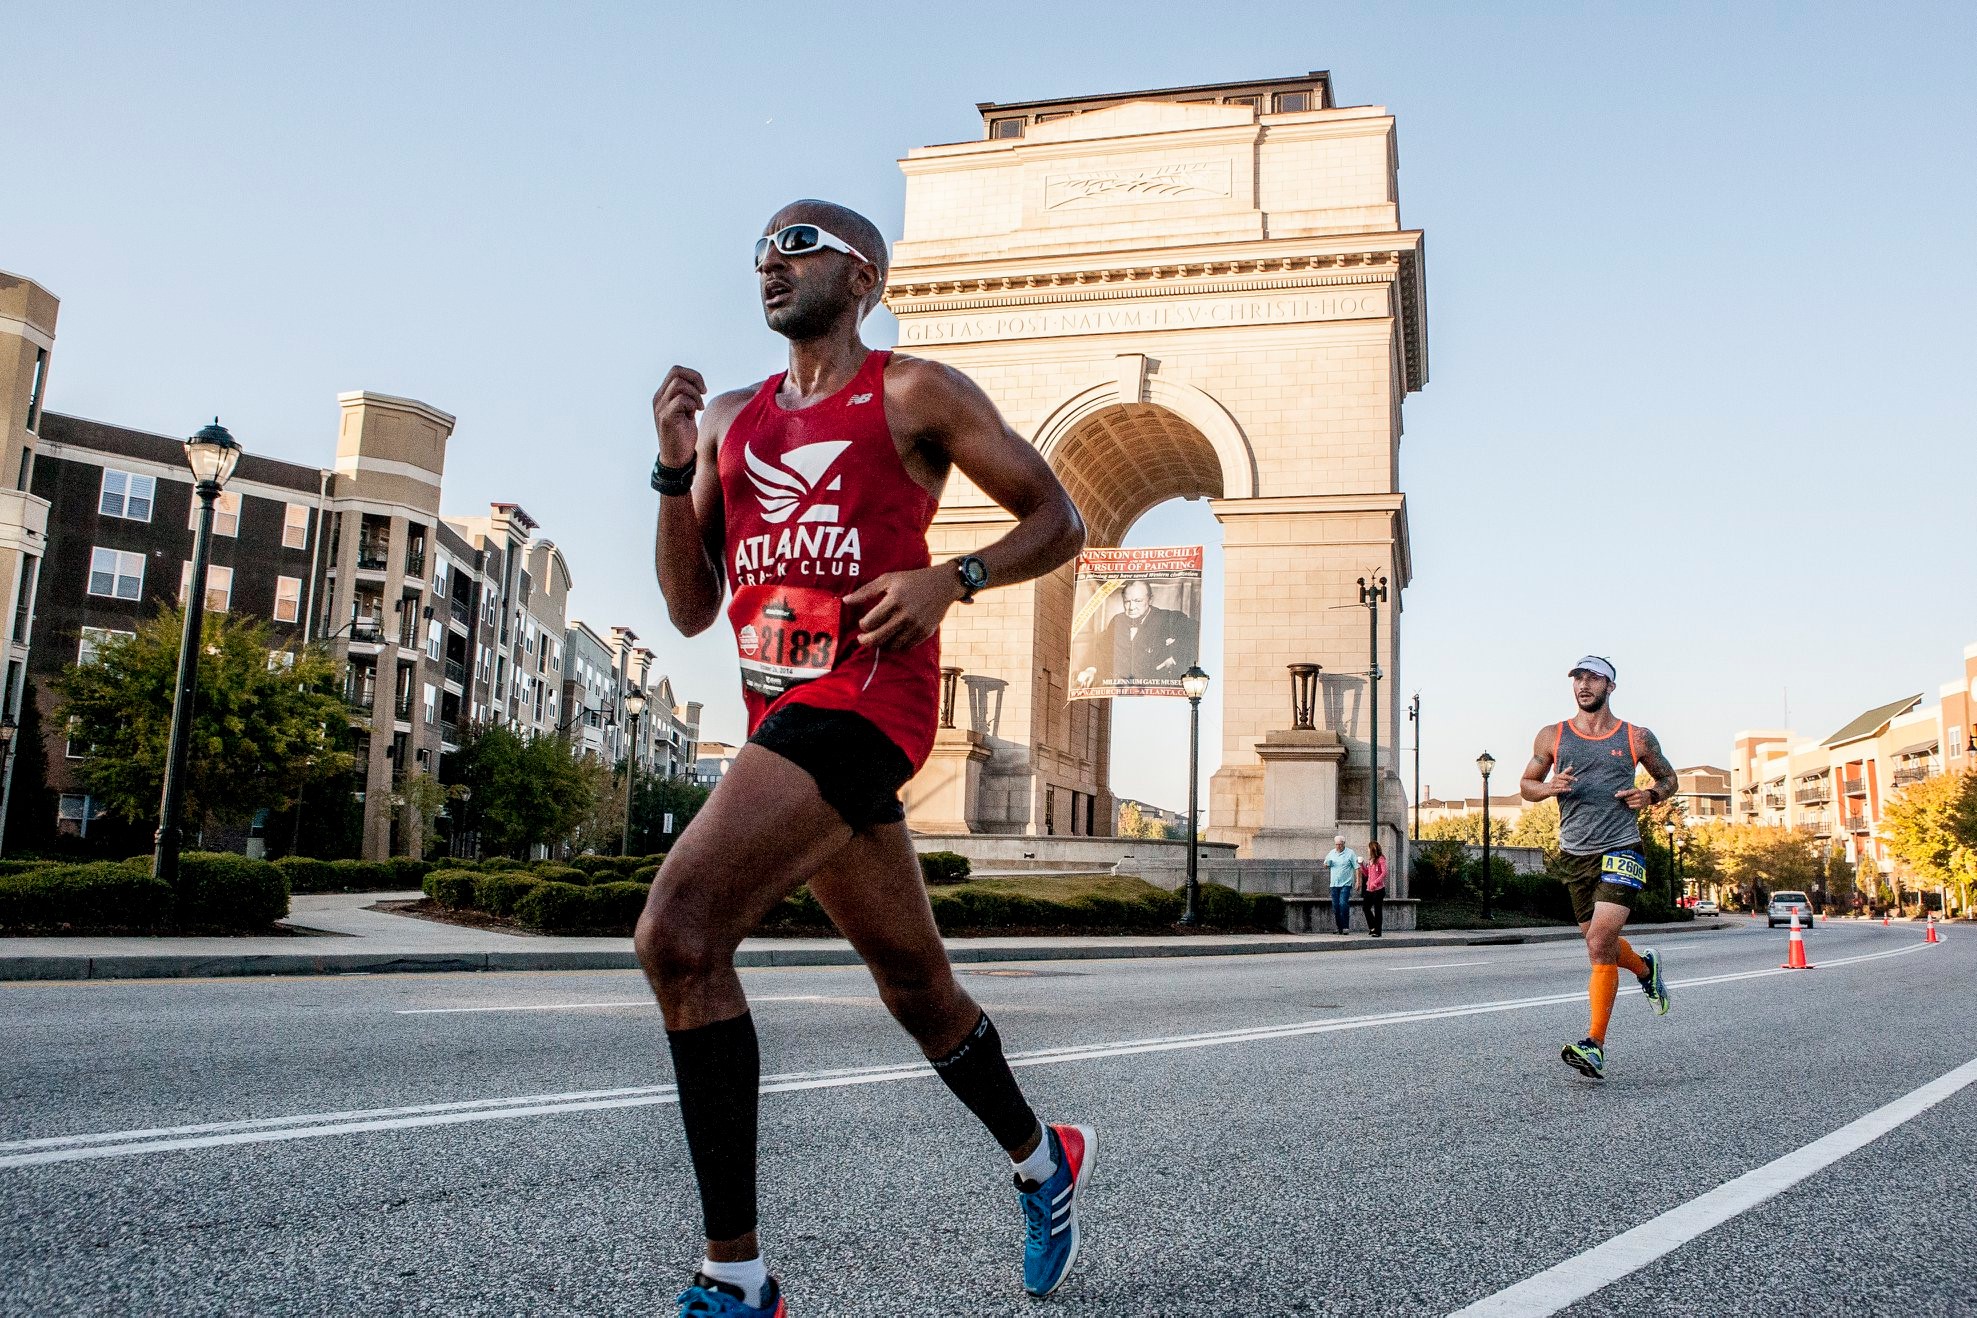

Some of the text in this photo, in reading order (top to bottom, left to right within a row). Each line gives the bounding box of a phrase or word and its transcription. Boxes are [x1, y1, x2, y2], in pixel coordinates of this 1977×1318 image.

[907, 295, 1377, 341] GESTAS POST NATVM IESV CHRISTI HOC
[735, 525, 861, 574] ATLANTA
[1132, 547, 1200, 560] CHURCHILL
[801, 561, 860, 576] CLUB
[1080, 560, 1195, 572] PURSUIT OF PAINTING
[760, 624, 832, 668] 2183
[1606, 857, 1613, 869] A
[1618, 859, 1643, 879] 2609
